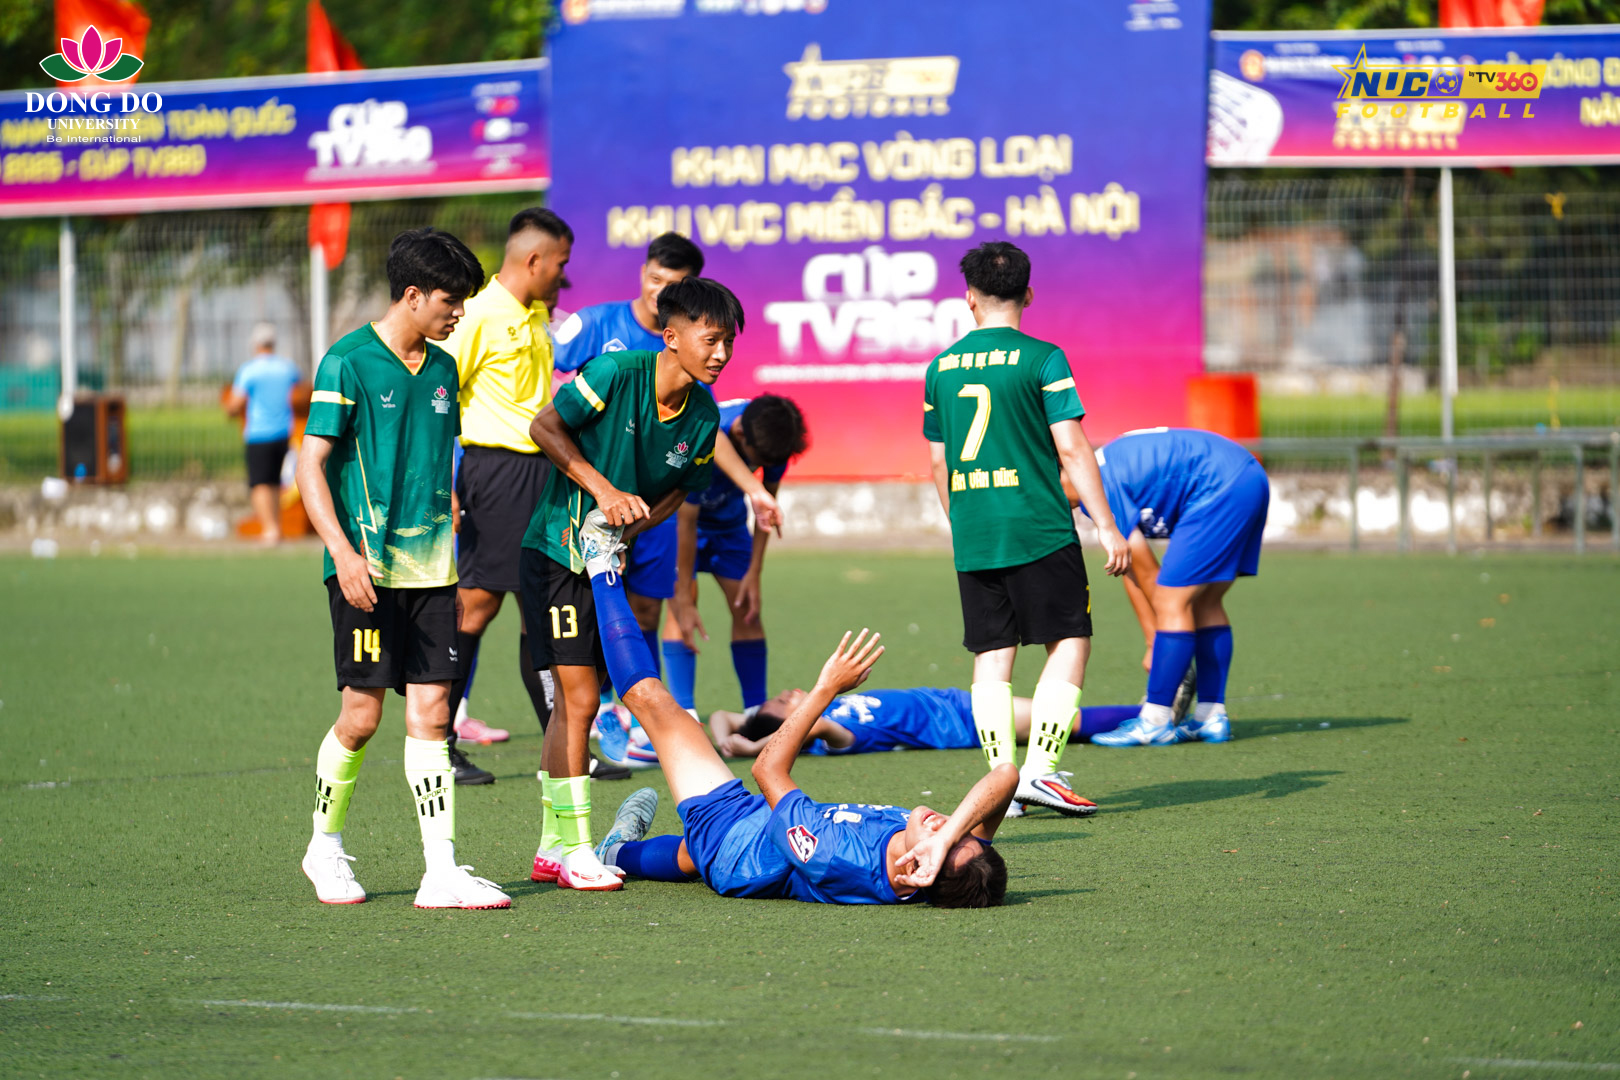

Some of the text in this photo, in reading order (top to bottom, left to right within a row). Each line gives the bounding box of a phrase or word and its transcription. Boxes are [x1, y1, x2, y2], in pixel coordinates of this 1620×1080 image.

[671, 130, 1073, 191] KHAI MẠC VÒNG LOẠI
[694, 200, 783, 252] VỰC
[888, 183, 976, 241] BẮC
[1005, 184, 1067, 237] HÀ
[1070, 181, 1140, 241] NỘI
[803, 245, 938, 302] CÚP
[763, 298, 976, 359] TV360
[958, 384, 992, 462] 7
[353, 628, 381, 662] 14
[549, 605, 579, 639] 13
